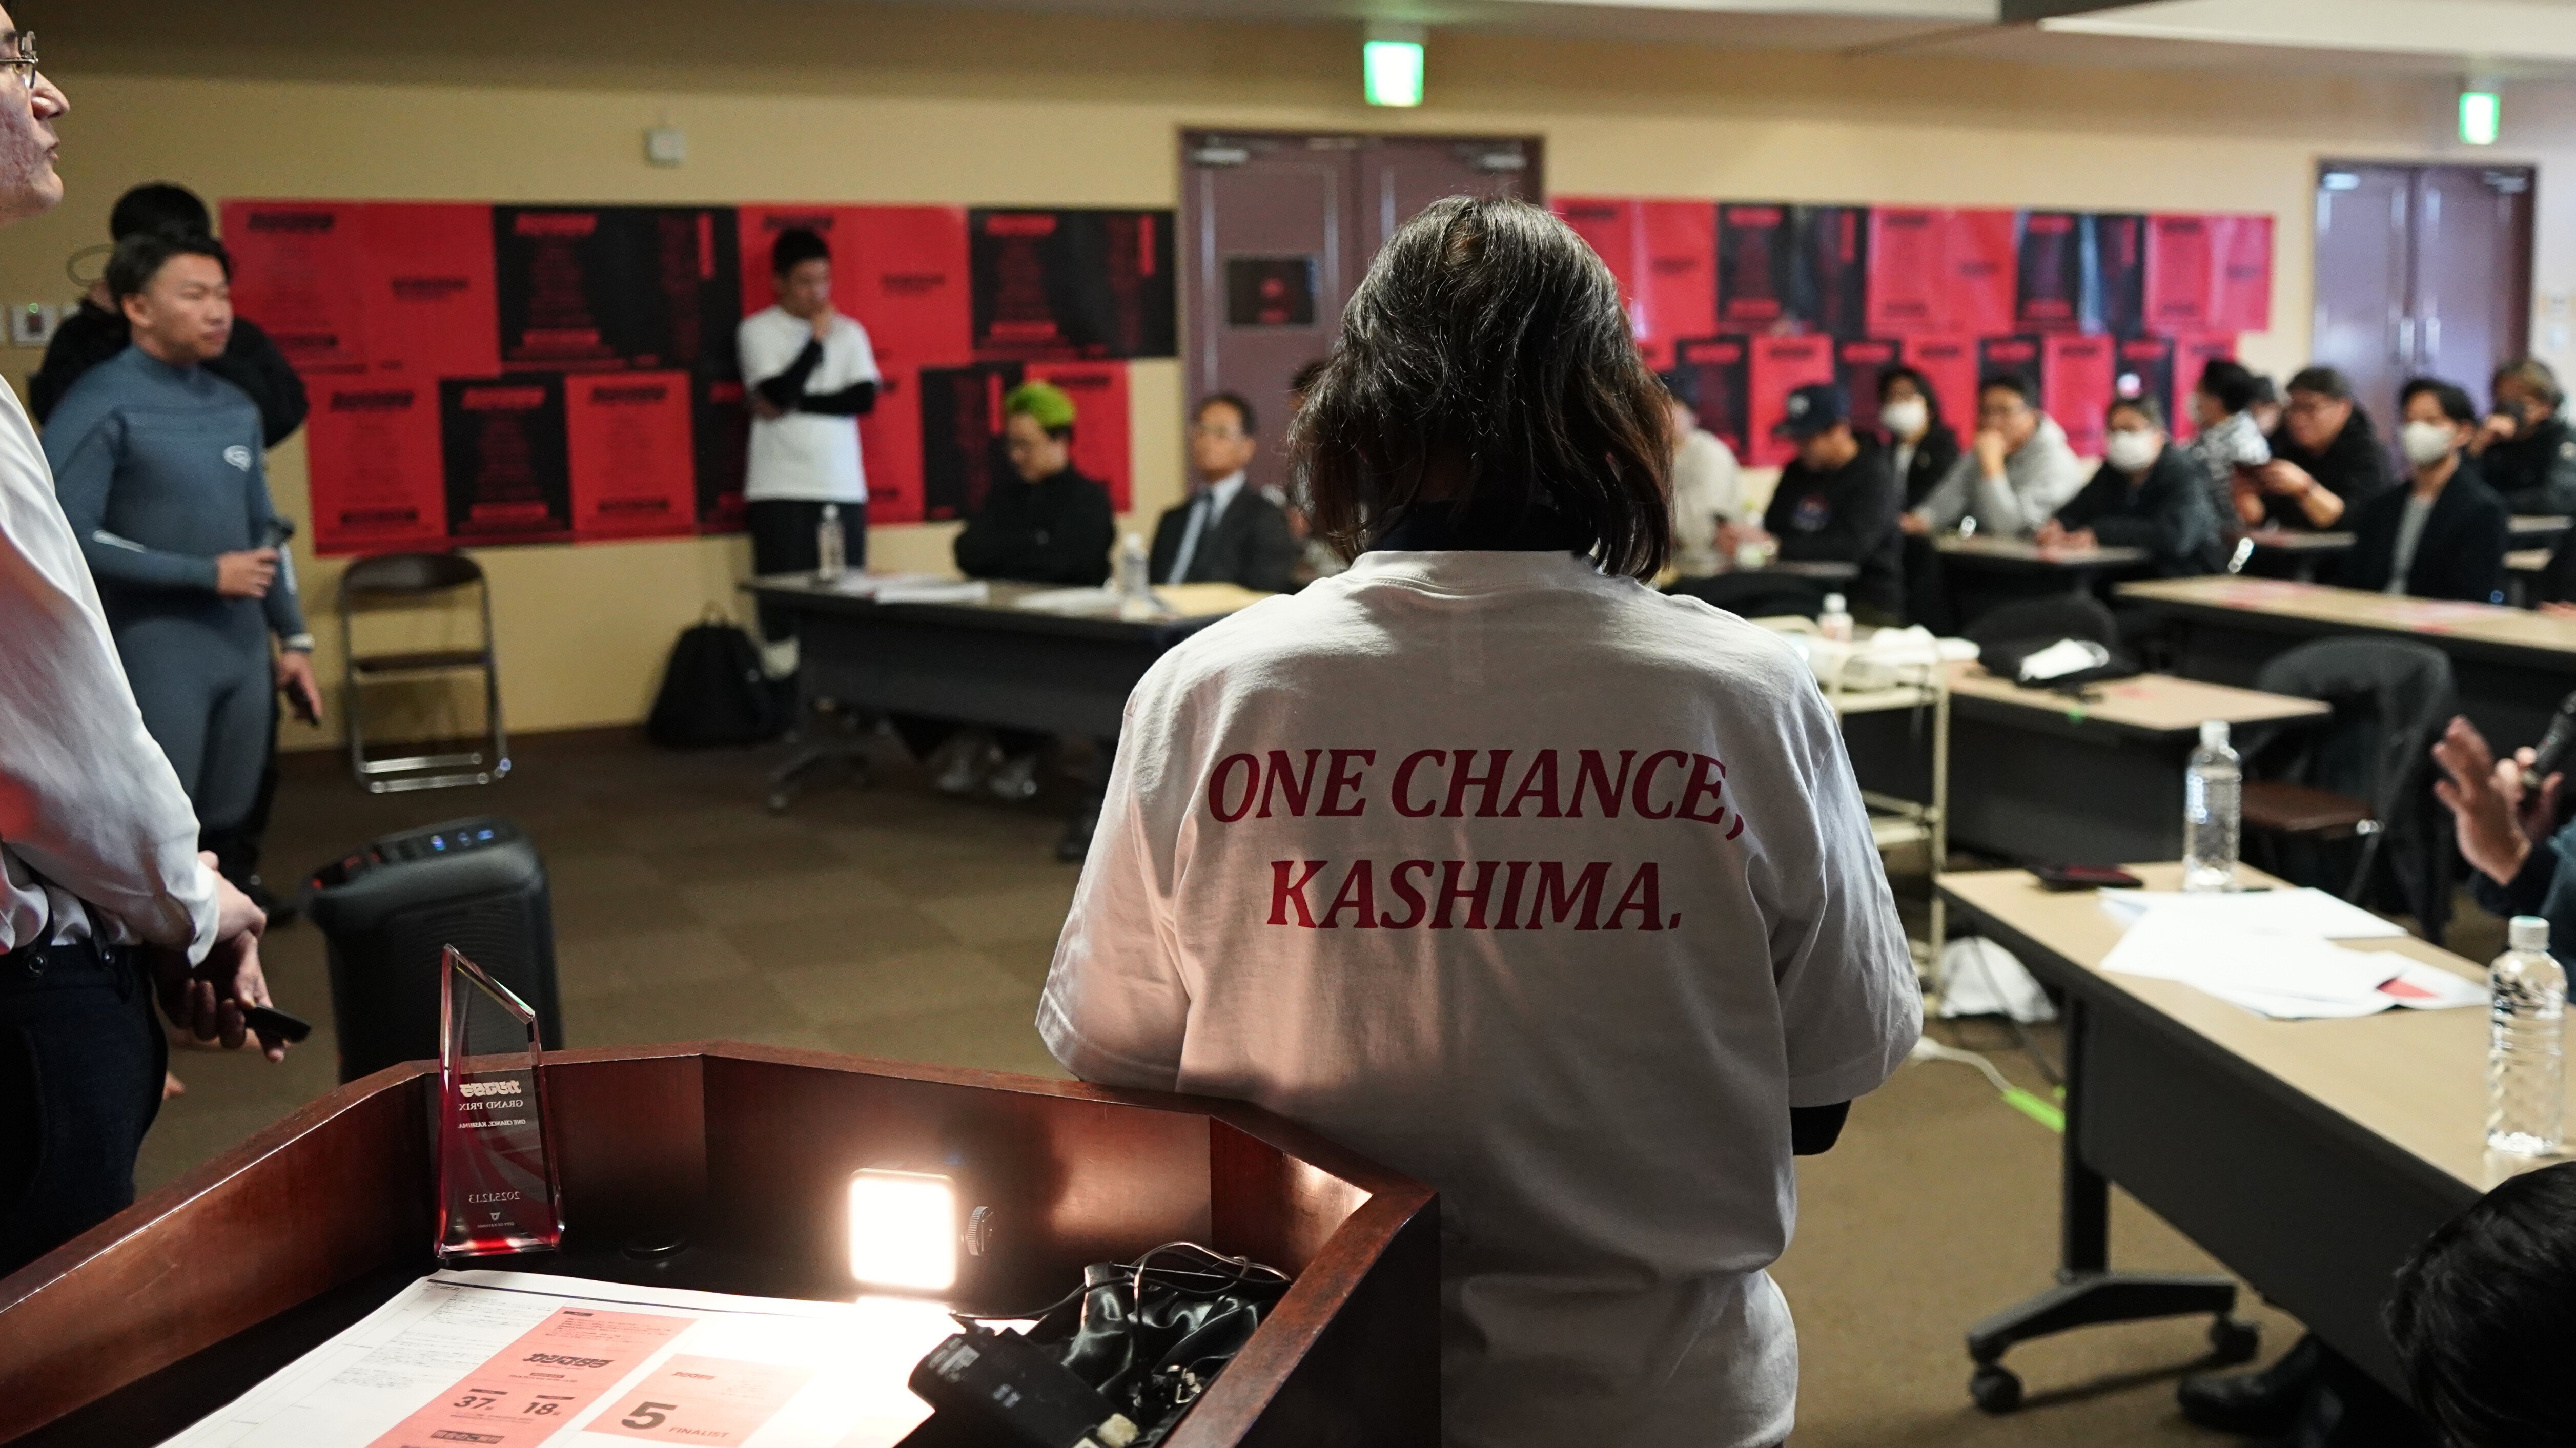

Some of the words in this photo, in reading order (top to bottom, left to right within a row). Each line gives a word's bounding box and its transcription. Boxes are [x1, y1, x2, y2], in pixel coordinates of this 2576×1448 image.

[1207, 748, 1377, 823] ONE
[1391, 749, 1744, 841] CHANCE,
[1266, 859, 1683, 931] KASHIMA.
[453, 1396, 496, 1410] 37
[522, 1402, 559, 1415] 18
[621, 1401, 679, 1430] 5
[668, 1426, 730, 1438] FINALIST
